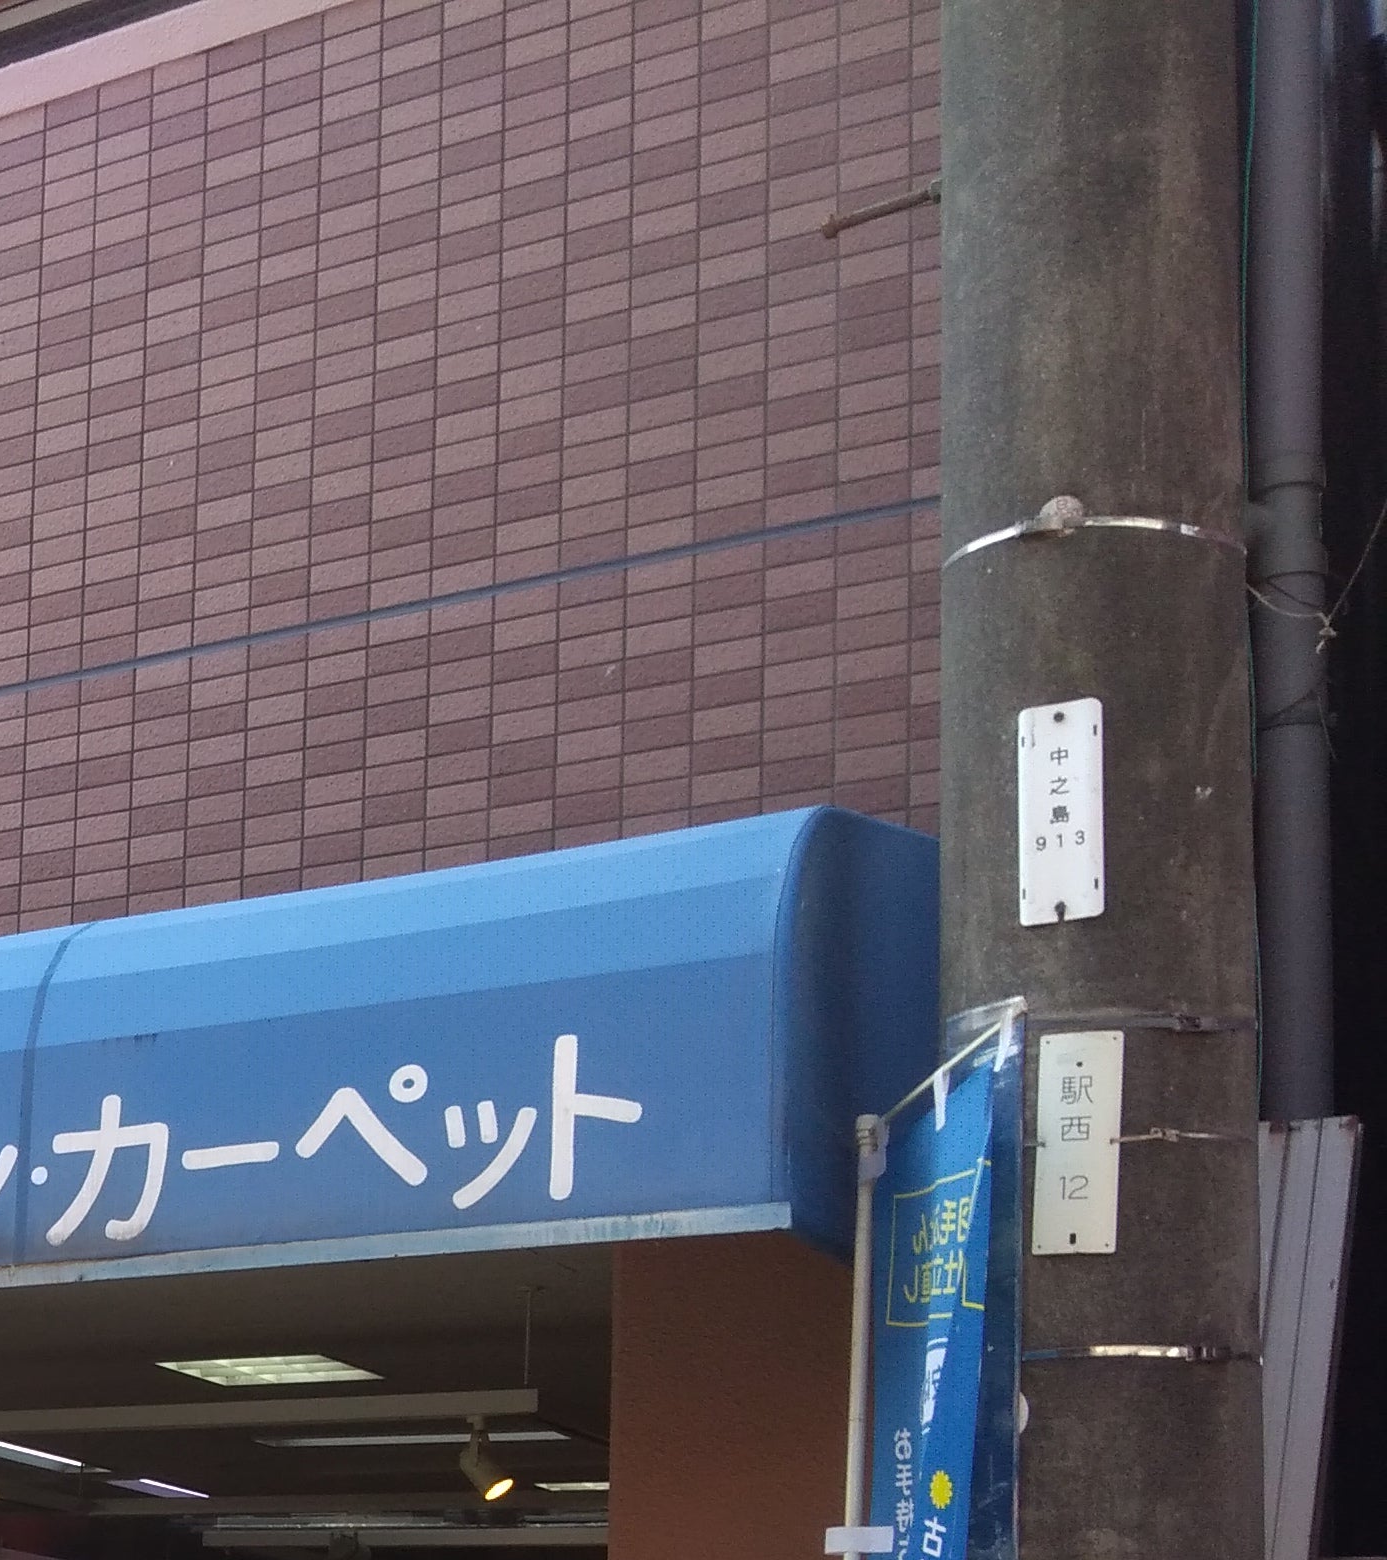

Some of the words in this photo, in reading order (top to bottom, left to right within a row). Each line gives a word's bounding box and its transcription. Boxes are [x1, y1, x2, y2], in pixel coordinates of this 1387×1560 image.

[1049, 746, 1070, 825] 中之島
[1034, 829, 1086, 852] 913
[1060, 1076, 1095, 1143] 駅西
[1059, 1175, 1089, 1202] 12
